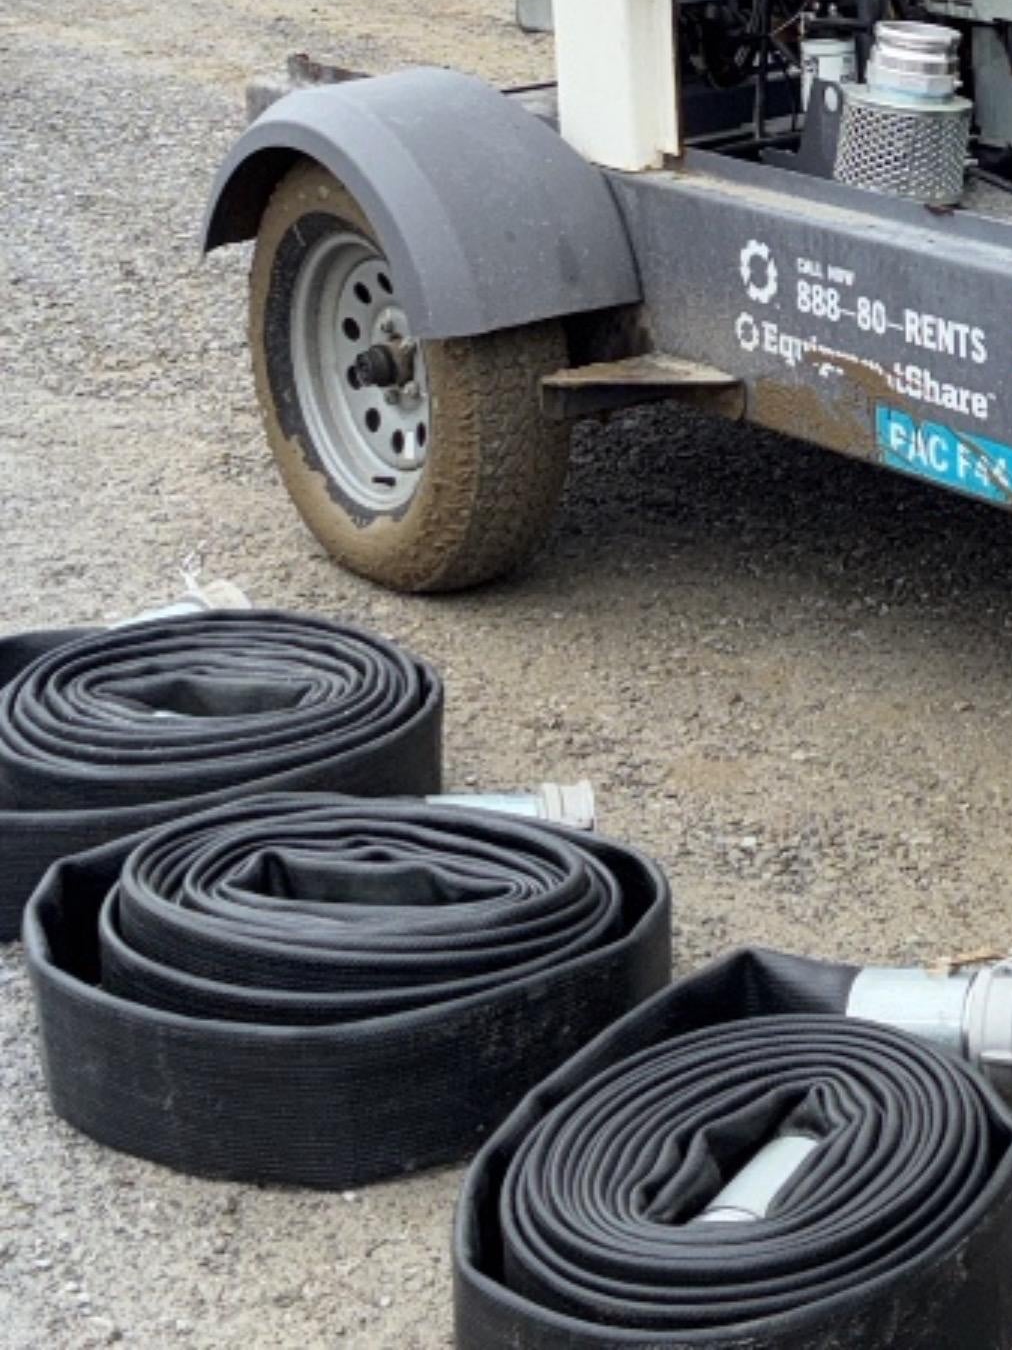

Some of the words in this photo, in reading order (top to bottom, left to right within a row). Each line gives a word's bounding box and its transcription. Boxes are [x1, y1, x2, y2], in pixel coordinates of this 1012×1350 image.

[797, 279, 988, 364] 888-80-RENTS
[761, 320, 988, 419] EquitShare
[889, 421, 949, 472] PAC
